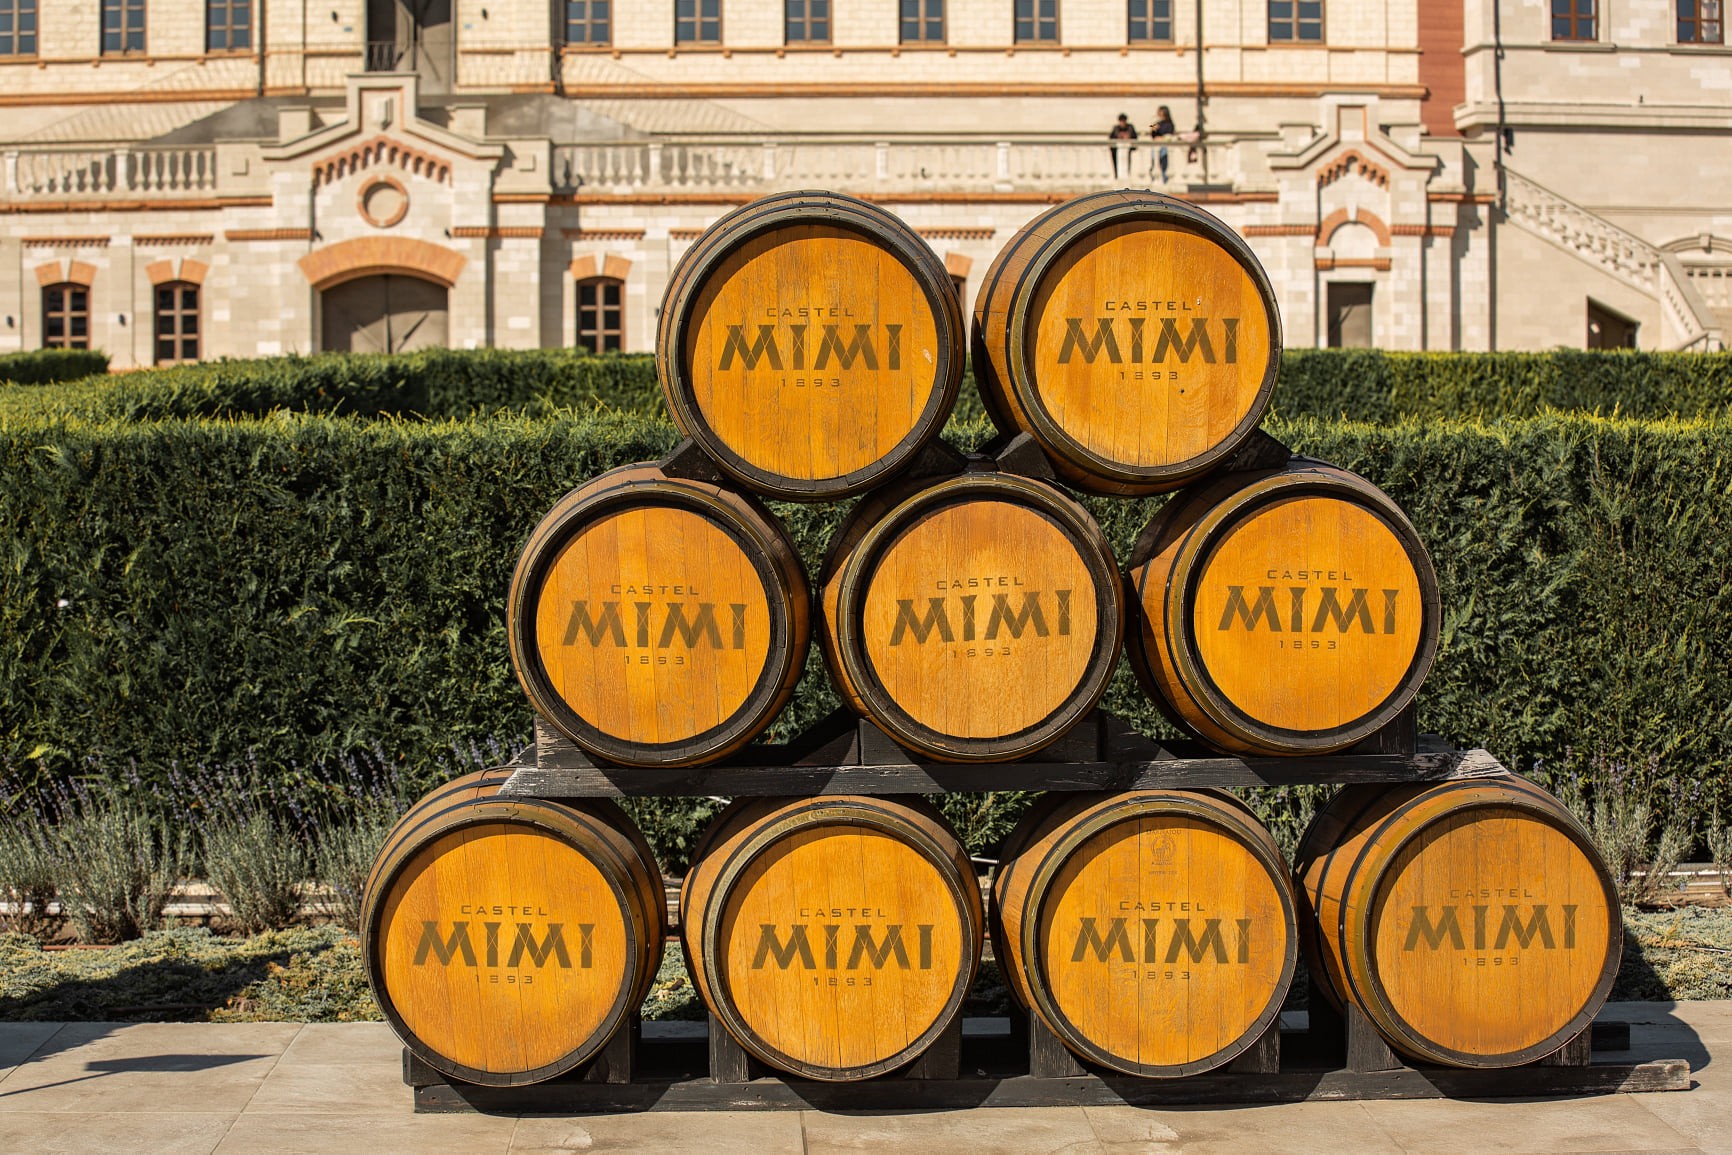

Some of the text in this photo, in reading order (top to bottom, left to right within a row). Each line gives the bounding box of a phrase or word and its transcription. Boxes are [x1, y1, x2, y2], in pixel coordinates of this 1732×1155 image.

[1106, 301, 1191, 310] CASTEL
[766, 308, 854, 317] CASTEL
[1057, 318, 1240, 363] MIMI
[718, 324, 903, 371] MIMI
[1120, 372, 1178, 380] 1893
[782, 379, 840, 387] 1893
[1267, 570, 1352, 580] CASTEL
[937, 577, 1024, 590] CASTEL
[611, 585, 699, 595] CASTEL
[1218, 586, 1399, 634] MIMI
[889, 590, 1072, 646] MIMI
[563, 601, 747, 649] MIMI
[1280, 640, 1336, 649] 1893
[953, 648, 1011, 658] 1893
[625, 656, 684, 664] 1893
[1451, 889, 1532, 898] CASTEL
[461, 905, 548, 916] CASTEL
[1120, 902, 1206, 911] CASTEL
[800, 908, 887, 918] CASTEL
[1403, 905, 1578, 950] MIMI
[412, 921, 595, 968] MIMI
[1071, 917, 1252, 964] MIMI
[752, 924, 934, 970] MIMI
[1463, 957, 1519, 966] 1893
[475, 975, 533, 983] 1893
[1133, 971, 1190, 979] 1893
[814, 977, 872, 986] 1893
